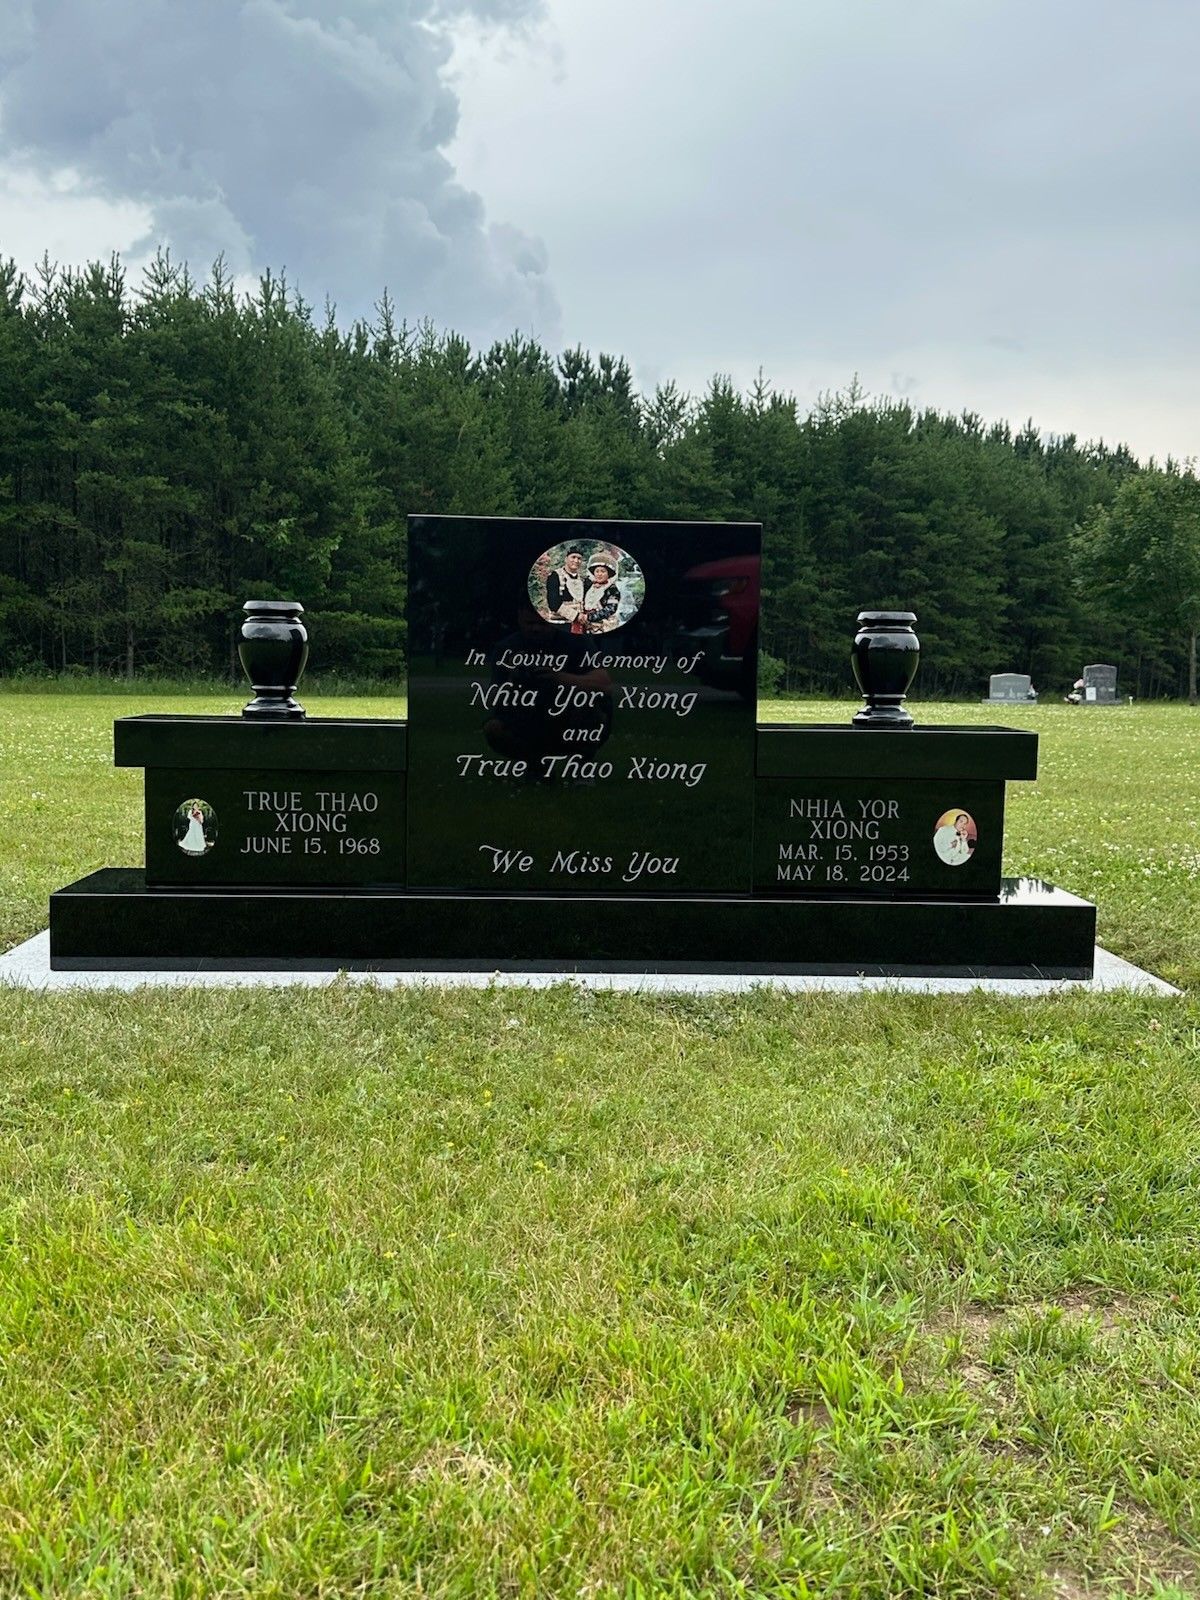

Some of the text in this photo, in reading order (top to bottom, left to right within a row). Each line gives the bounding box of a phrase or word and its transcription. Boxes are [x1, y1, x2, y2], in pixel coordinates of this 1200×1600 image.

[464, 649, 704, 675] In Loving Memory of
[469, 682, 699, 717] Nhia Yor Xiong
[562, 724, 604, 742] and
[456, 754, 708, 788] True Thao Xiong
[242, 791, 379, 812] TRUE THAO
[790, 799, 900, 819] NHIA YOR
[274, 812, 347, 833] XIONG
[809, 820, 880, 840] XIONG
[240, 837, 292, 854] JUNE
[339, 838, 381, 855] 1968
[779, 844, 824, 860] MAR.
[869, 845, 910, 862] 1953
[478, 845, 680, 883] We Miss You
[777, 865, 816, 881] MAY
[860, 866, 910, 882] 2024
